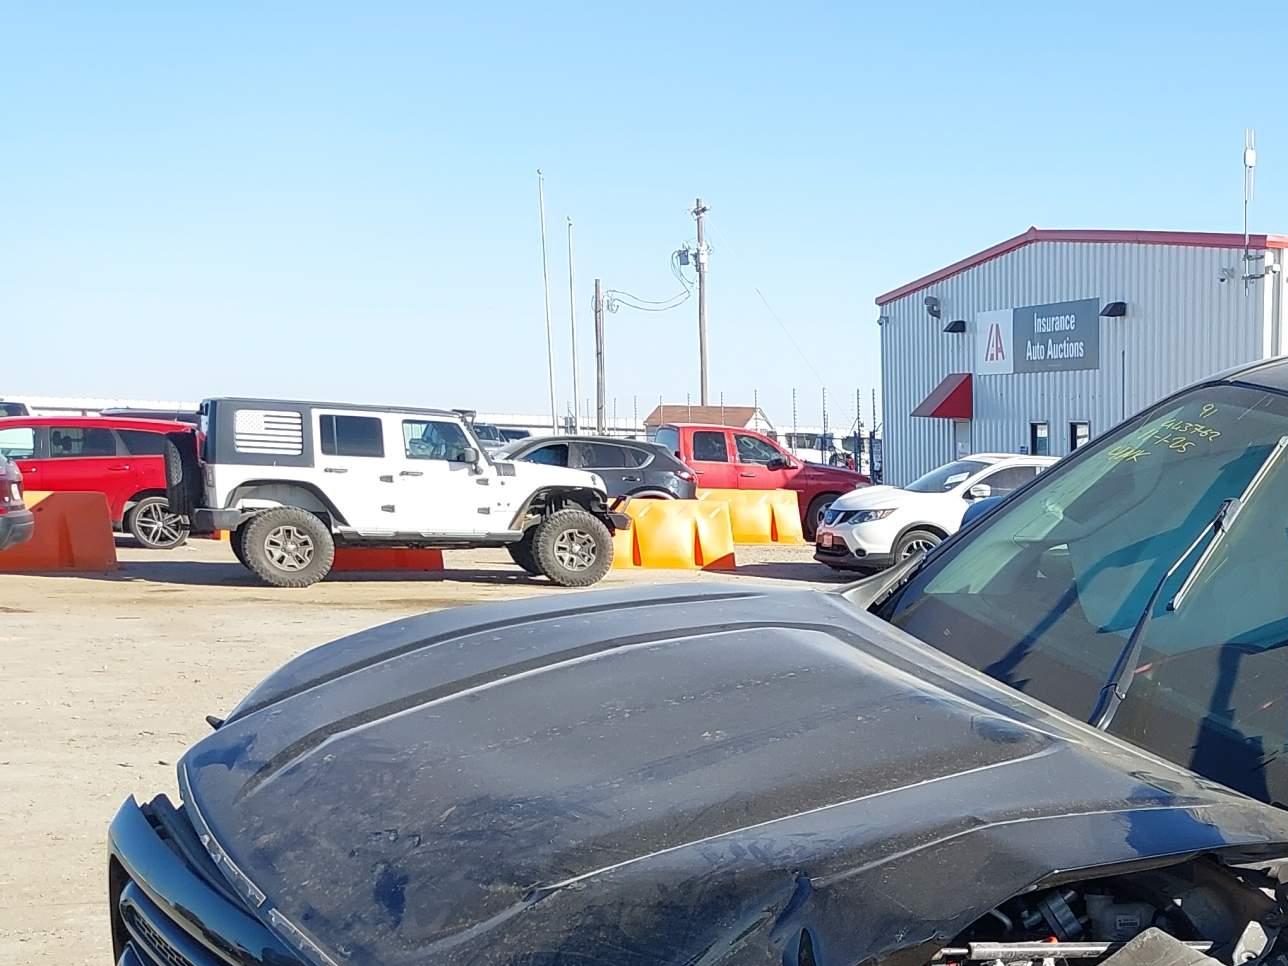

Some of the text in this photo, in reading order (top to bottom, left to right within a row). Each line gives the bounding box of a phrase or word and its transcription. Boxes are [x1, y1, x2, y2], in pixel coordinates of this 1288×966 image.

[1034, 312, 1076, 334] Insurance
[1026, 337, 1085, 361] Auto Auctions
